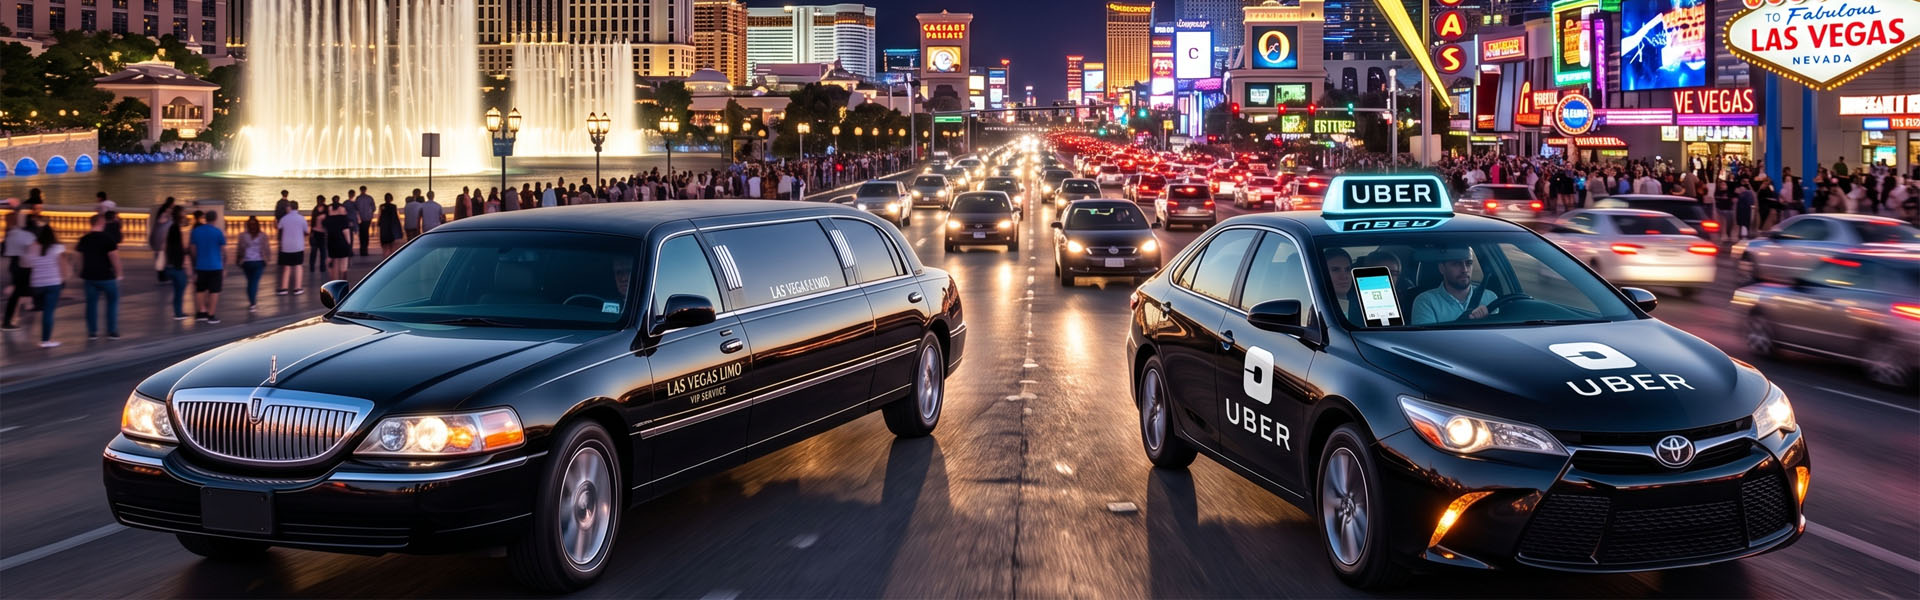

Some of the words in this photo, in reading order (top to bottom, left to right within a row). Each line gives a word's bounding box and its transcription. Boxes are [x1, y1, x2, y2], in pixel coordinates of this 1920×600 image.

[1765, 13, 1781, 23] TO
[1786, 3, 1881, 25] Fabulous
[1751, 26, 1798, 52] LAS
[1807, 18, 1905, 49] VEGAS
[1188, 47, 1199, 59] C
[1792, 54, 1852, 65] NEVADA
[1673, 90, 1694, 114] VE
[1697, 88, 1754, 114] VEGAS
[1351, 184, 1432, 204] UBER
[769, 284, 787, 299] LAS
[667, 378, 686, 397] LAS
[687, 369, 718, 390] VEGAS
[719, 362, 742, 381] LIMO
[1566, 373, 1696, 396] UBER
[690, 395, 701, 404] VIP
[1225, 397, 1291, 452] UBER
